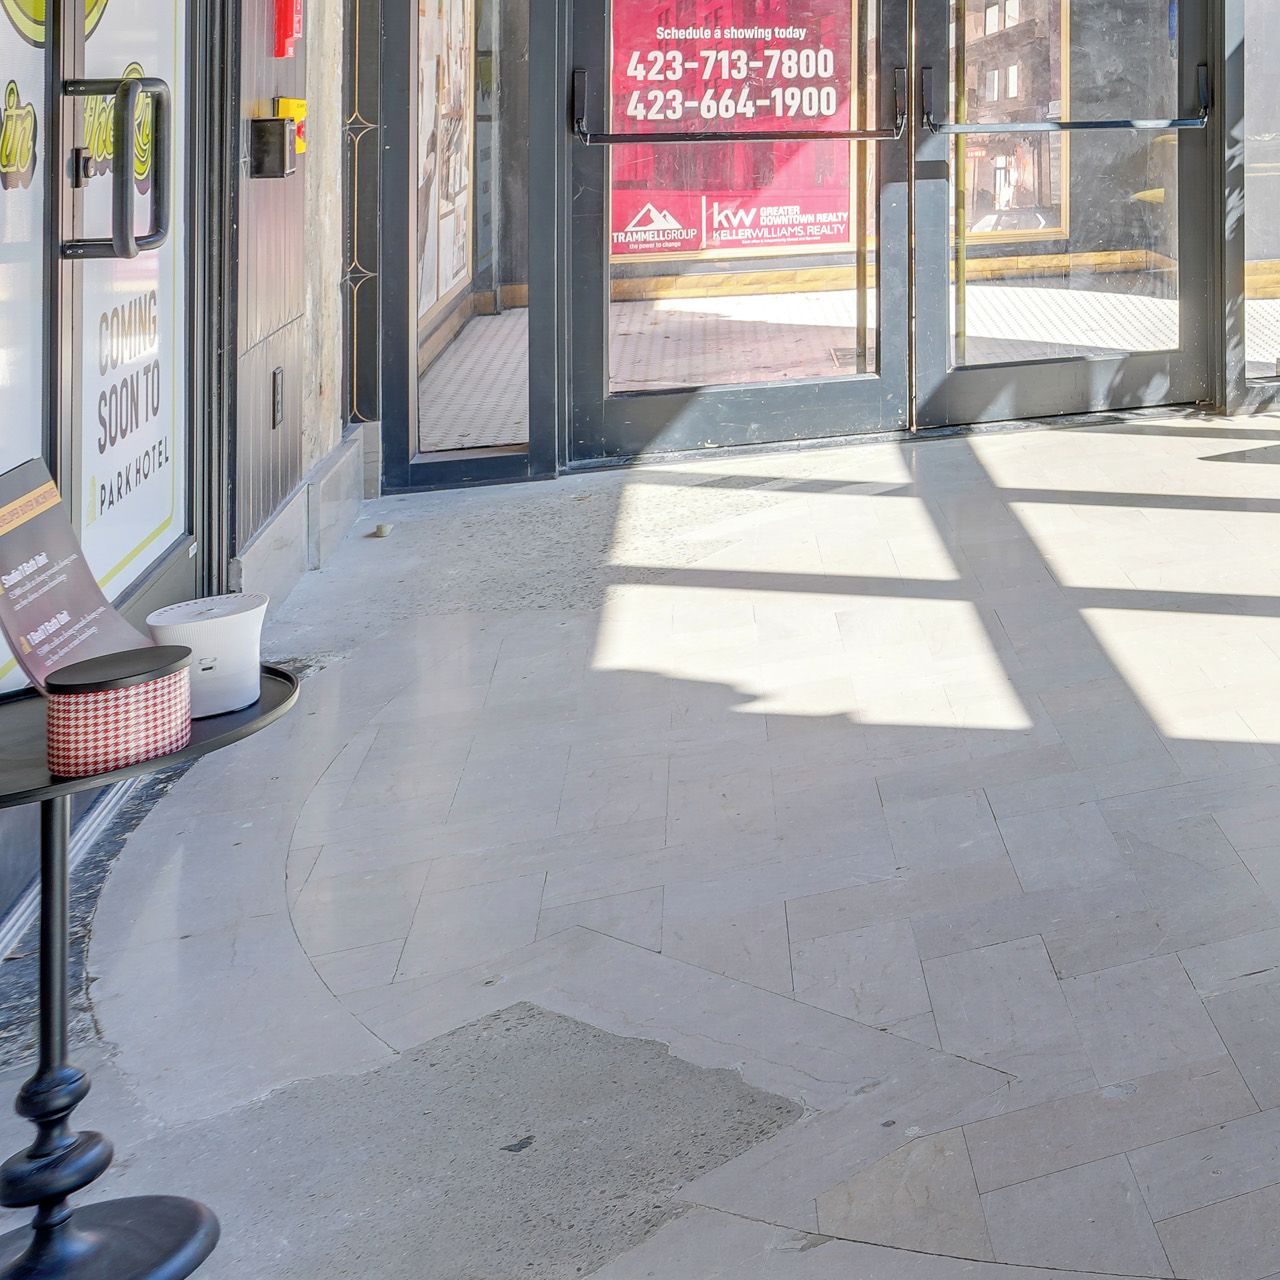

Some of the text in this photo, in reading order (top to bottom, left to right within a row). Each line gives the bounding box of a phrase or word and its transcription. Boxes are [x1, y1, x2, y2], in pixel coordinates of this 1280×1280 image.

[656, 26, 711, 39] Schedule
[724, 26, 772, 41] showing
[774, 26, 806, 40] today
[626, 48, 834, 81] 423-713-7800
[626, 86, 837, 120] 423-664-1900
[760, 205, 800, 216] GREATER
[760, 211, 849, 226] DOWNTOWN REALTY
[611, 228, 697, 243] TRAMMELLGROUP
[808, 223, 846, 236] REALTY
[639, 242, 655, 251] power
[662, 241, 681, 250] change
[99, 289, 157, 377] COMING
[98, 358, 160, 455] SOON TO
[99, 435, 169, 516] PARK HOTEL
